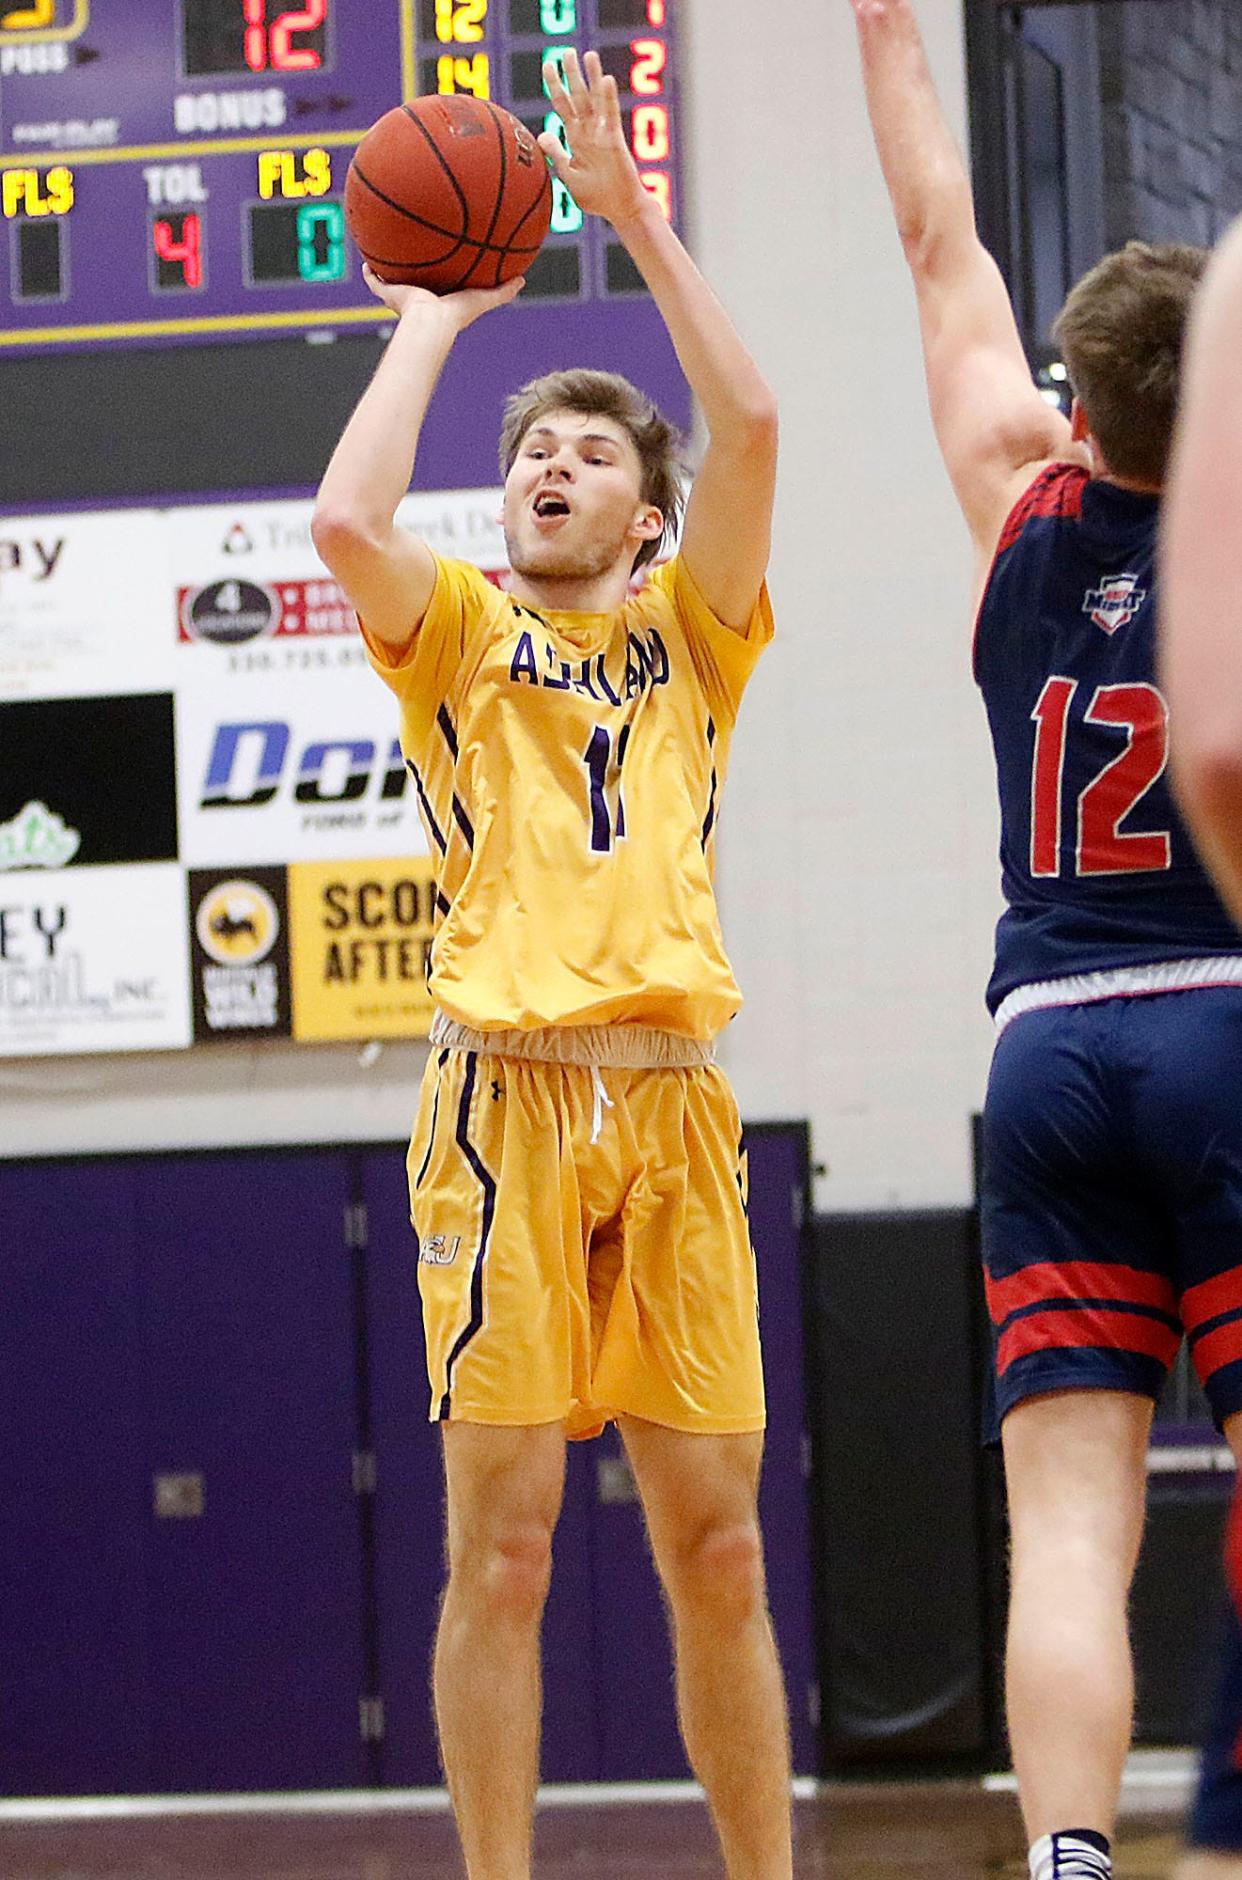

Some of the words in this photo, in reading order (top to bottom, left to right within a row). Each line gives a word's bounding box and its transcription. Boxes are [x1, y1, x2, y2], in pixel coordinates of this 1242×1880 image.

[243, 0, 328, 72] 12
[434, 0, 488, 43] 12
[437, 52, 490, 100] 14
[630, 38, 668, 96] 2
[174, 87, 287, 133] BONUS
[631, 103, 670, 163] 0
[2, 165, 75, 218] FLS
[142, 164, 209, 204] TOL
[257, 147, 332, 200] FLS
[151, 213, 202, 288] 4
[296, 202, 346, 282] 0
[215, 580, 243, 612] 4
[1030, 675, 1172, 878] 12
